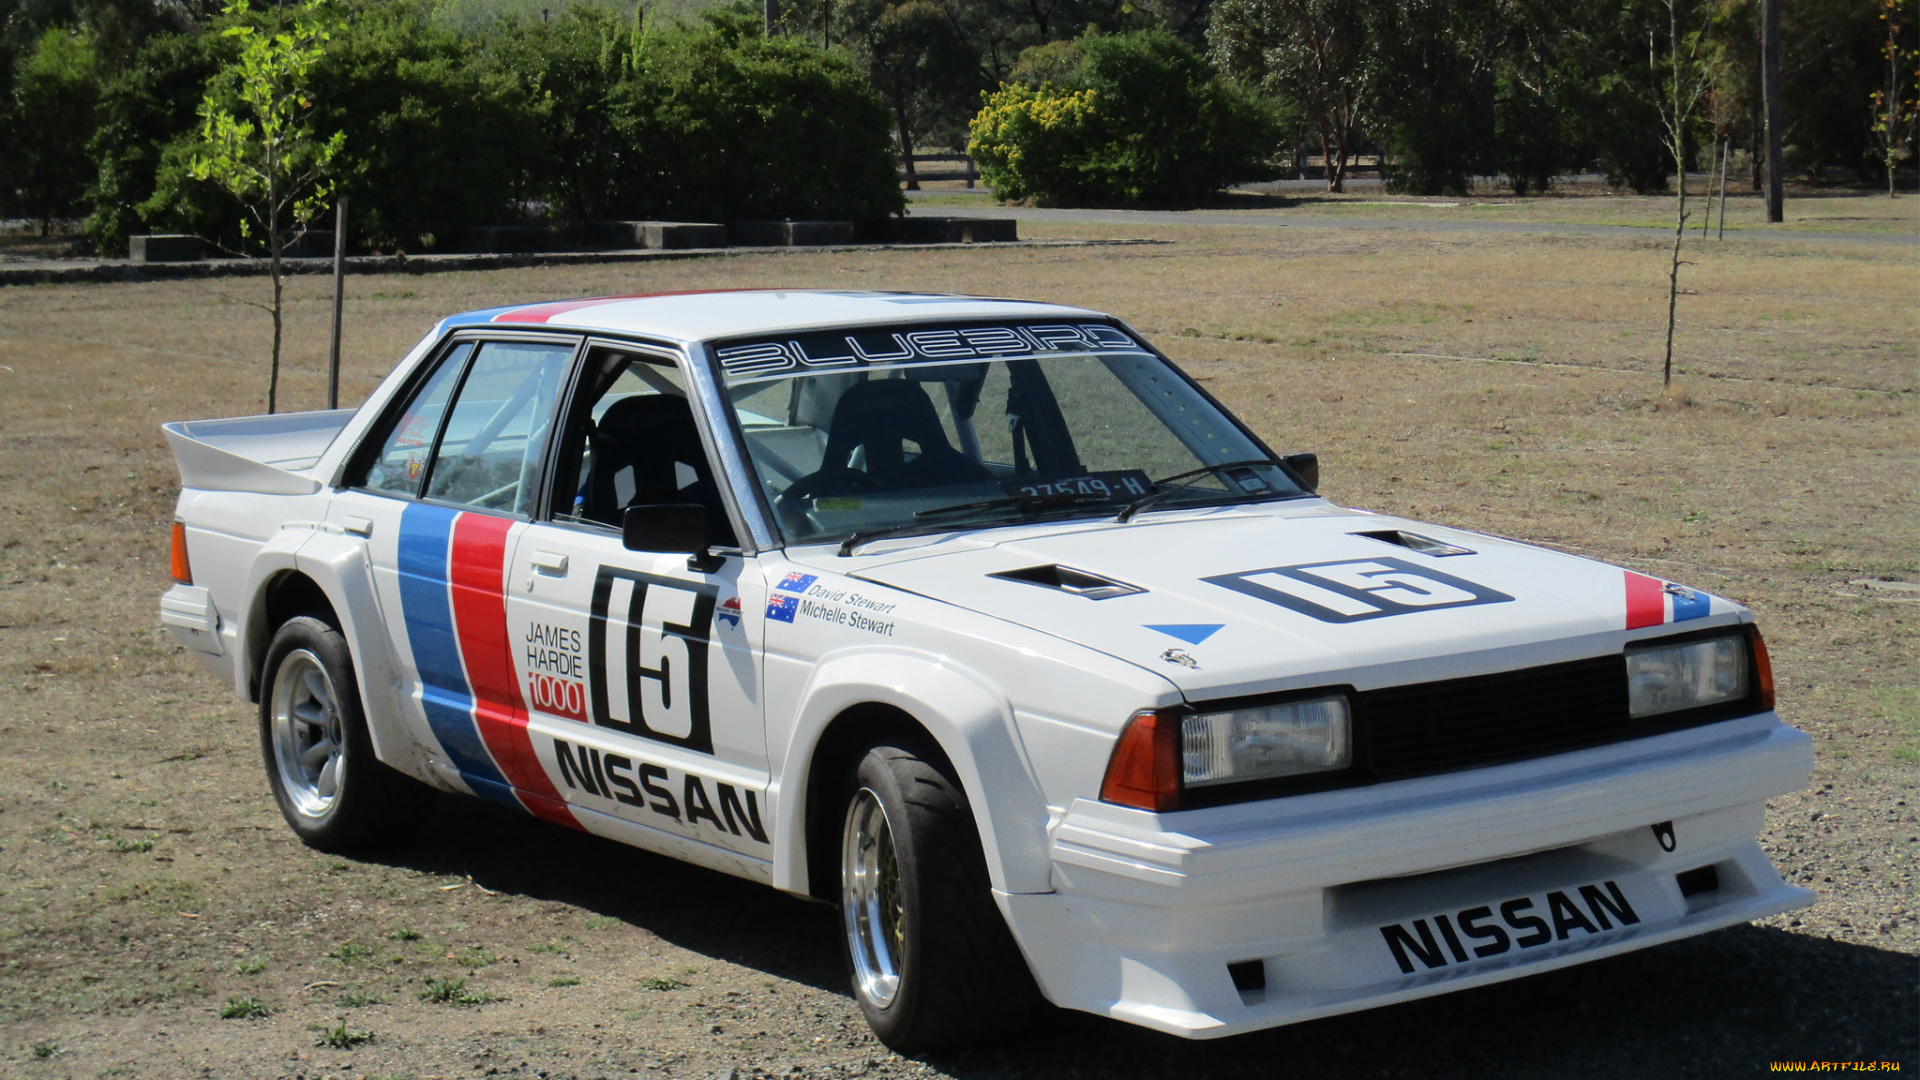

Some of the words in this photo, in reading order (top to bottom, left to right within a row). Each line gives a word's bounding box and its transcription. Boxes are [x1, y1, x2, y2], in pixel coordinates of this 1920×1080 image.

[718, 324, 1138, 377] BLUEBIRD
[808, 584, 845, 602] David
[845, 593, 897, 614] Stewart
[1238, 562, 1478, 616] 15
[526, 621, 581, 653] JAMES
[799, 600, 847, 625] Michelle
[848, 611, 895, 637] Stewart
[526, 645, 583, 679] HARDIE
[608, 577, 698, 739] 15
[528, 672, 581, 714] 1000
[553, 738, 770, 844] NISSAN
[1379, 881, 1641, 974] NISSAN
